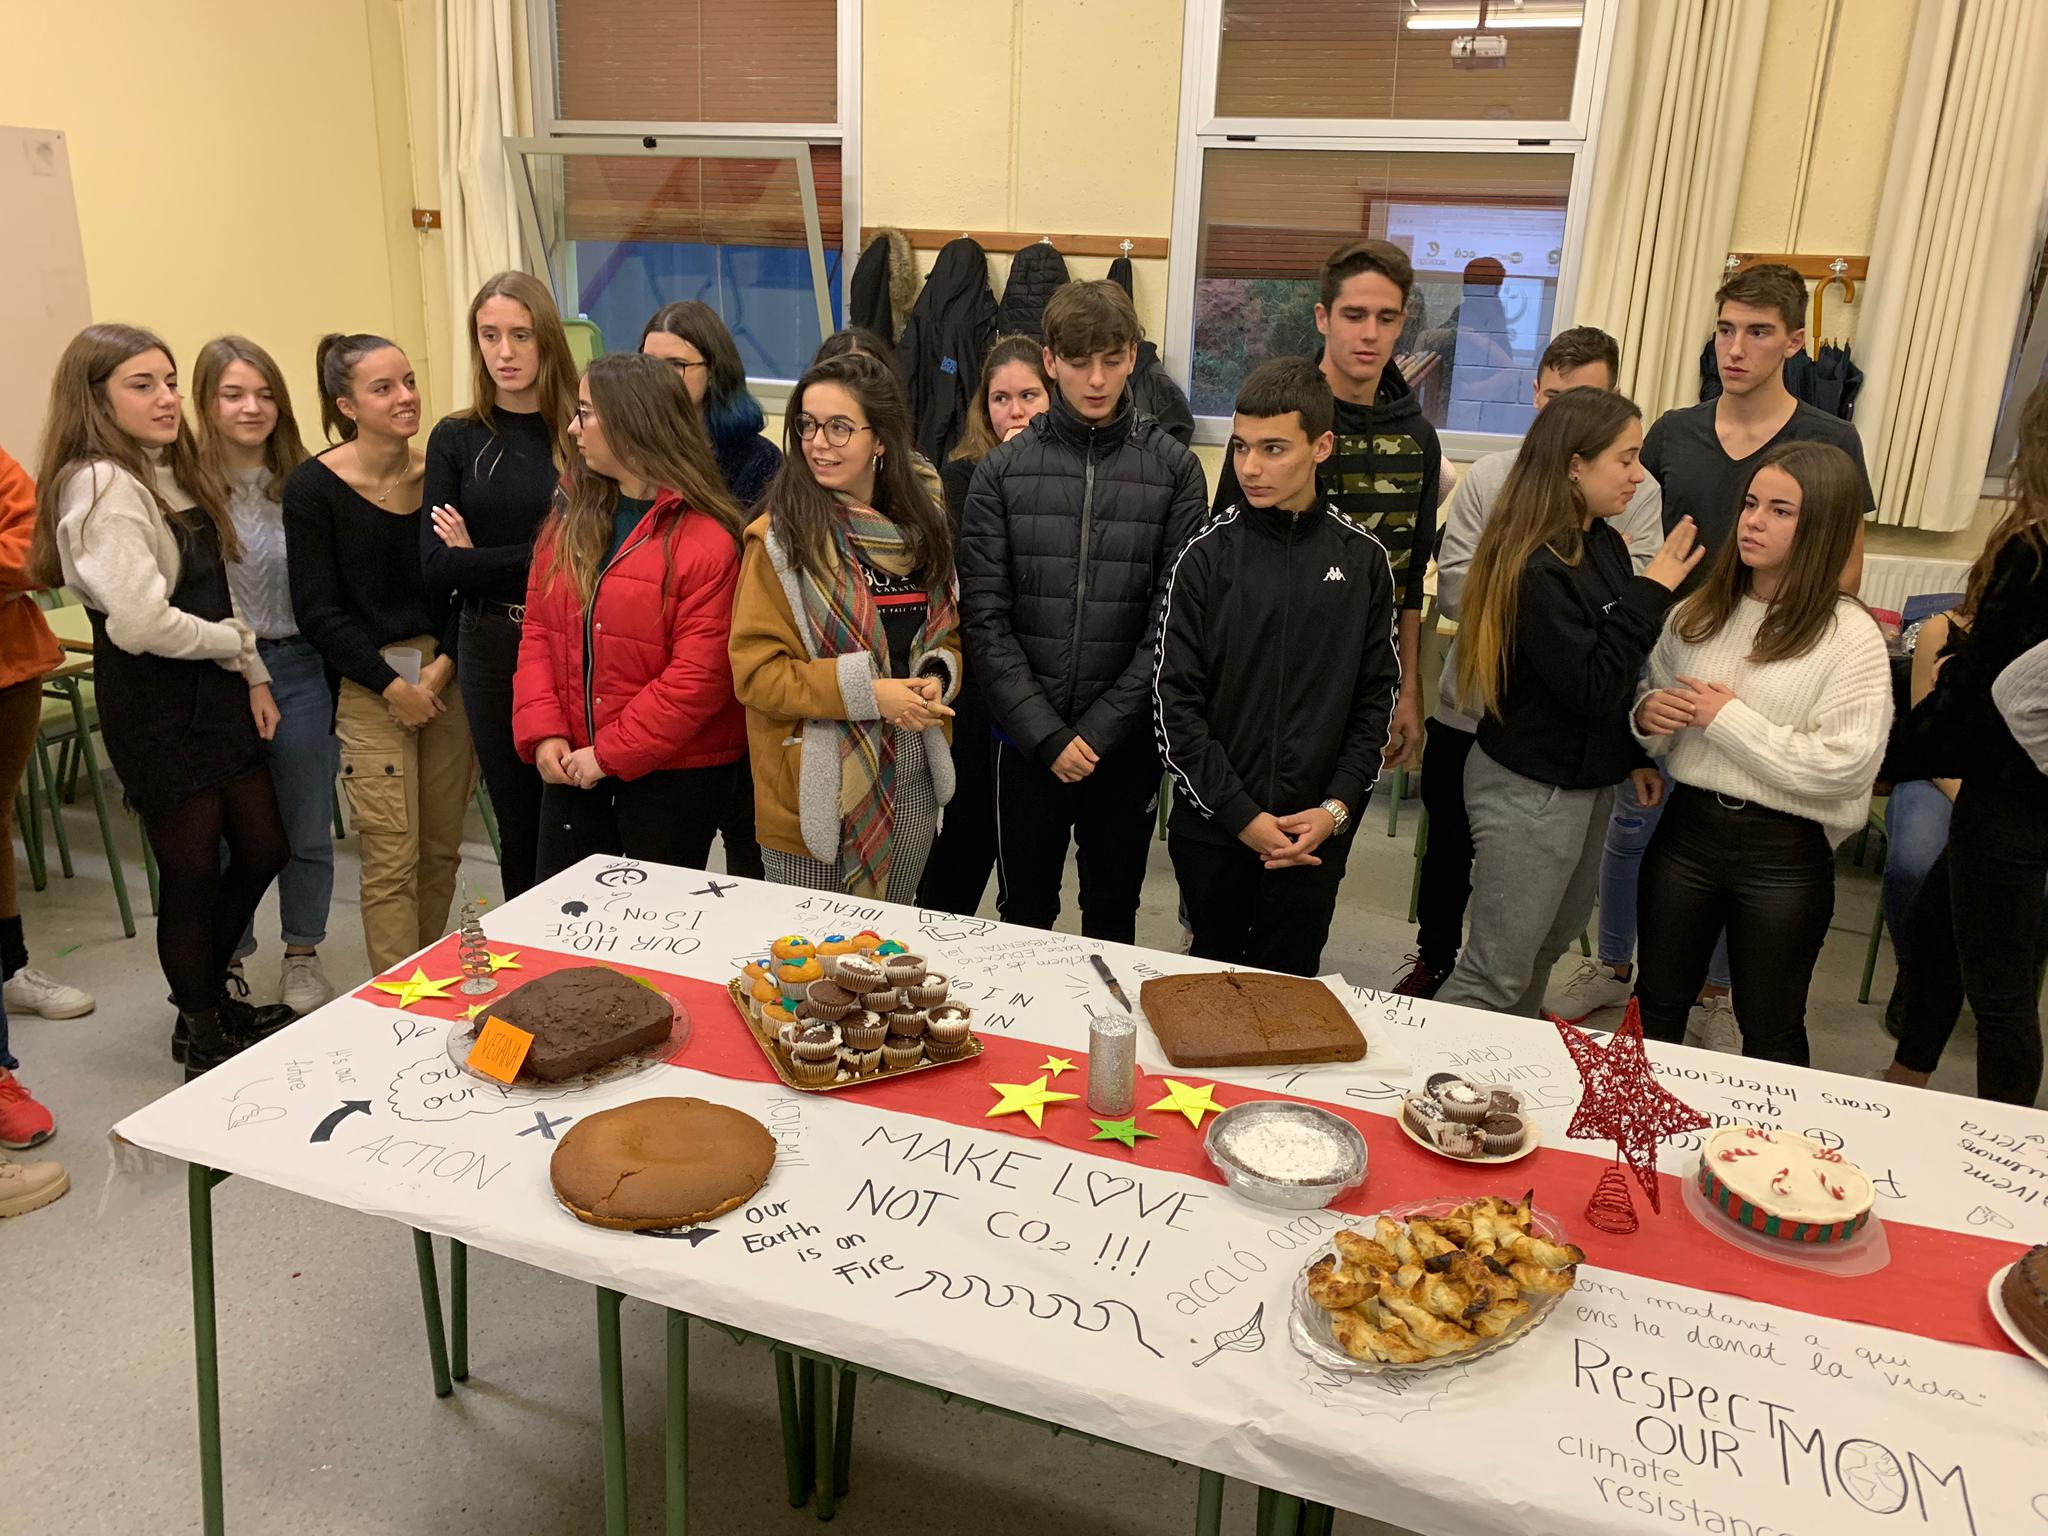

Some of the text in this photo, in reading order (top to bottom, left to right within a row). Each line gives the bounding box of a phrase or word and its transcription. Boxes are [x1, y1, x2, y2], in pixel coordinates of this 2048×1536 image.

[622, 907, 708, 931] IS ON
[629, 935, 701, 956] OUR
[975, 934, 1067, 954] AMBIENTAL
[1008, 992, 1034, 1008] NI
[1353, 986, 1414, 1011] HAN
[983, 1012, 1016, 1030] NI
[1384, 1008, 1426, 1029] IT'S
[482, 1029, 522, 1072] VEGANA
[1440, 1044, 1512, 1069] CRIME
[285, 1059, 314, 1092] future
[420, 1065, 462, 1085] ou
[1457, 1063, 1552, 1086] CLIMAT
[423, 1087, 482, 1110] our
[1720, 1095, 1782, 1118] que
[1821, 1092, 1892, 1119] Grans
[346, 1132, 512, 1192] ACTION
[862, 1125, 1042, 1191] MAKE
[846, 1177, 959, 1229] NOT
[741, 1219, 822, 1256] Earth
[796, 1229, 866, 1264] is on
[832, 1250, 905, 1286] Fire
[1166, 1241, 1269, 1317] acció
[1575, 1304, 1619, 1330] ens
[1633, 1312, 1666, 1340] ha
[1687, 1324, 1787, 1368] donat
[1808, 1351, 1854, 1381] la
[1646, 1295, 1782, 1337] matant
[1803, 1331, 1833, 1352] a
[1854, 1344, 1914, 1371] qui
[1557, 1433, 1685, 1489] climate
[1635, 1415, 1744, 1479] OUR
[1778, 1416, 1980, 1536] MOM
[1592, 1475, 1793, 1536] resistanc
